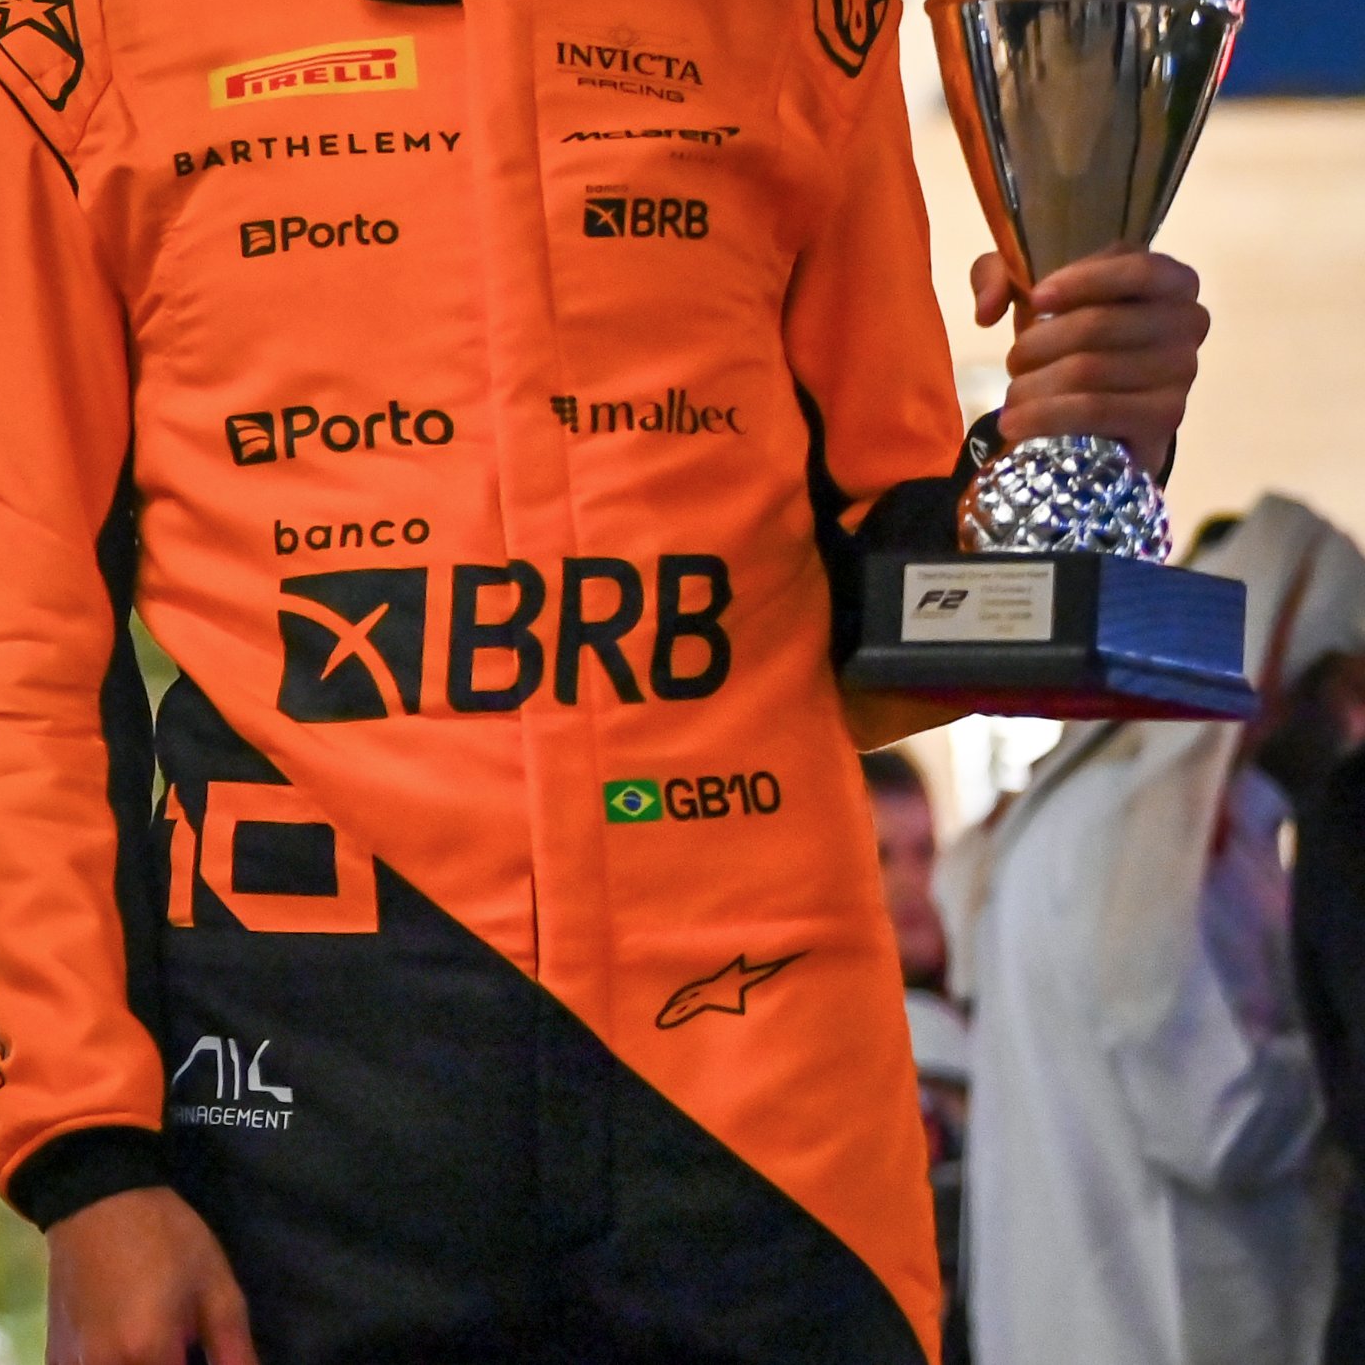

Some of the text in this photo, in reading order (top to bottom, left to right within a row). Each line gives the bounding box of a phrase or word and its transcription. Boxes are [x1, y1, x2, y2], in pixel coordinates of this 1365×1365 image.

[225, 48, 397, 99] PIRELLI
[556, 42, 703, 86] INVICTA
[577, 76, 685, 104] RACING
[173, 131, 461, 177] BARTHELEMY
[281, 213, 400, 252] Porto
[630, 197, 710, 240] BRB
[280, 400, 455, 460] Porto
[589, 387, 747, 436] malbec
[273, 517, 431, 555] banco
[916, 588, 969, 611] F2
[445, 554, 734, 714] BRB
[664, 770, 781, 822] GB10
[163, 780, 380, 934] 10
[173, 1105, 294, 1130] ANAGEMENT
